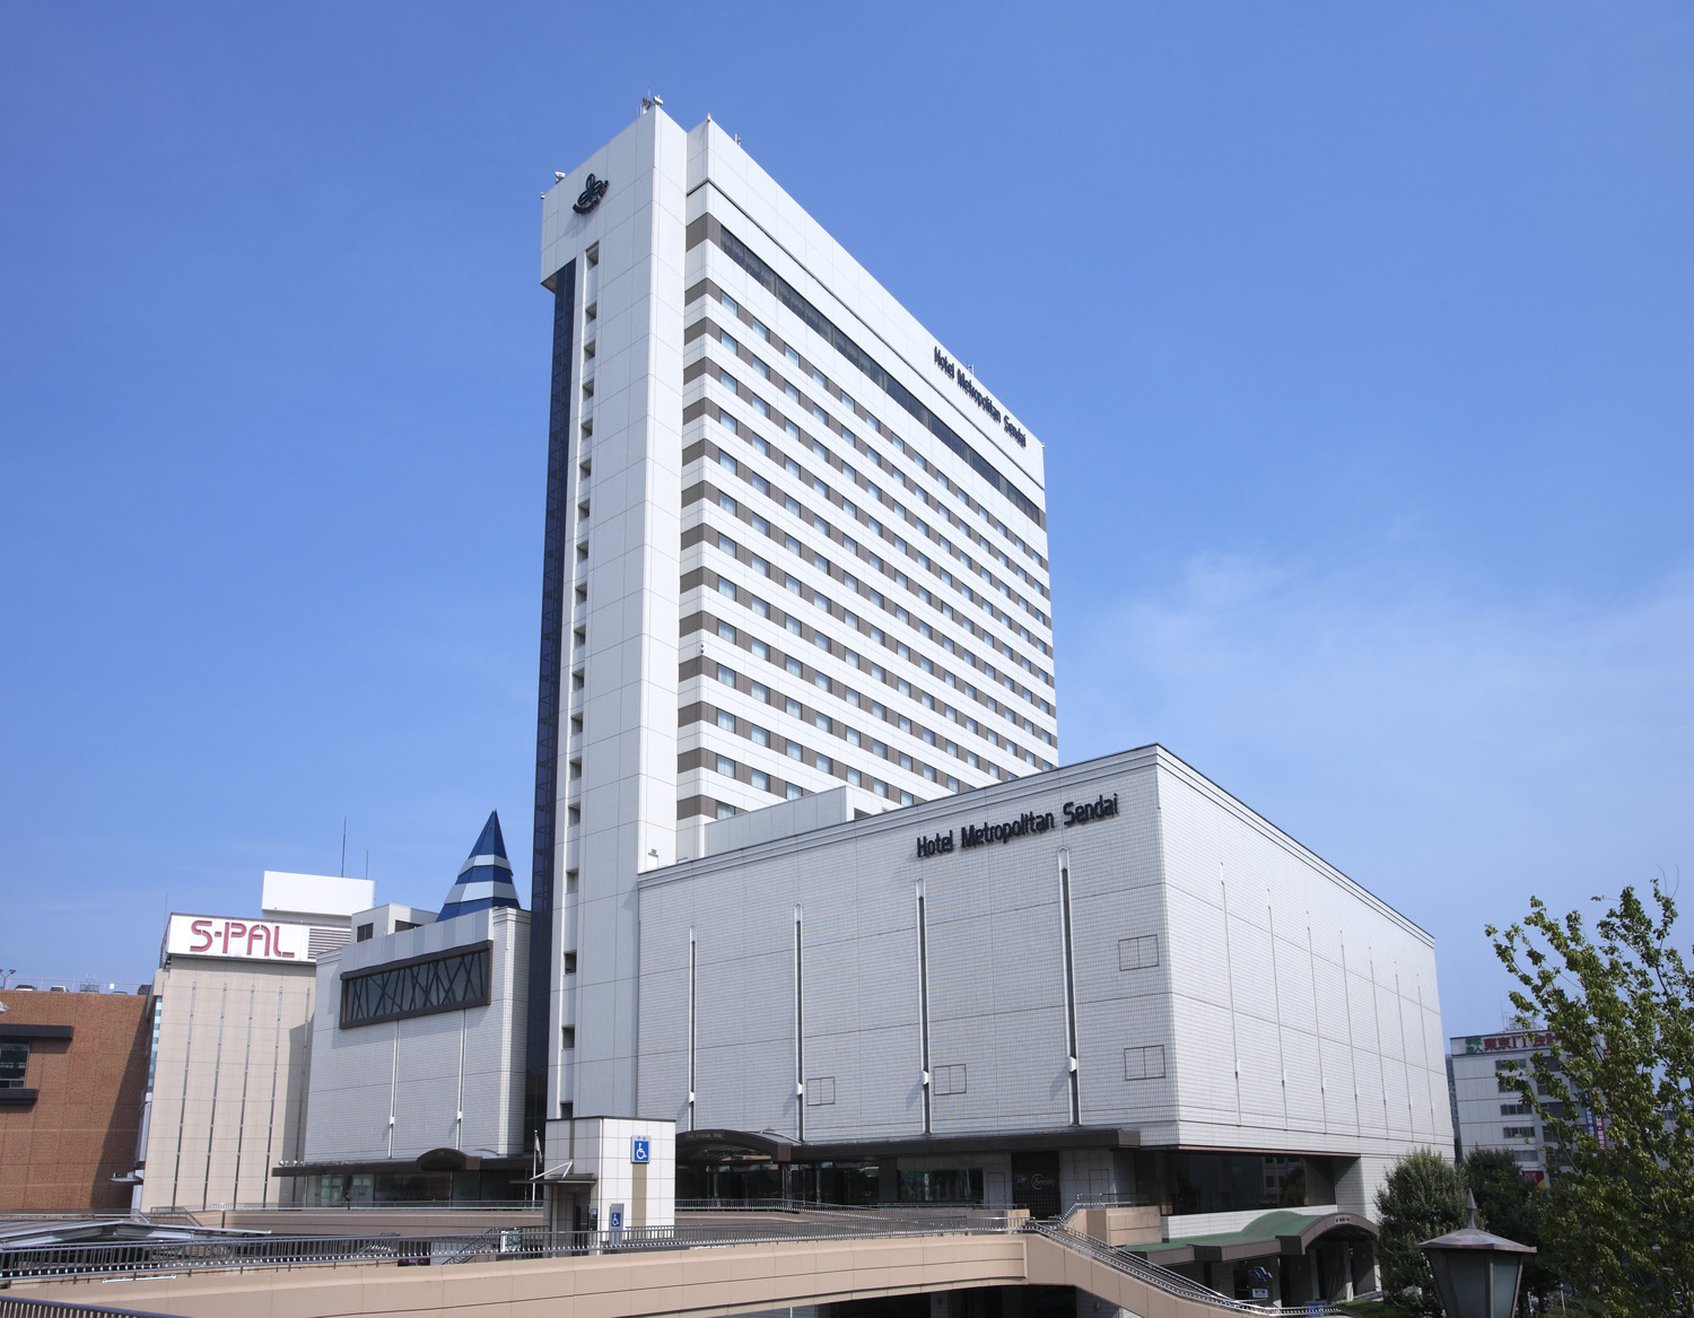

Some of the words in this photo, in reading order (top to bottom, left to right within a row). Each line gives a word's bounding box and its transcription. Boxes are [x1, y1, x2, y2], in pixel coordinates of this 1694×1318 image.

[934, 346, 954, 379] Hotel
[957, 368, 1001, 423] Metropolitan
[1004, 415, 1026, 448] Sendai
[917, 830, 954, 858] Hotel
[961, 811, 1055, 848] Metropolitan
[1063, 793, 1119, 827] Sendai
[190, 920, 295, 958] S-PAL
